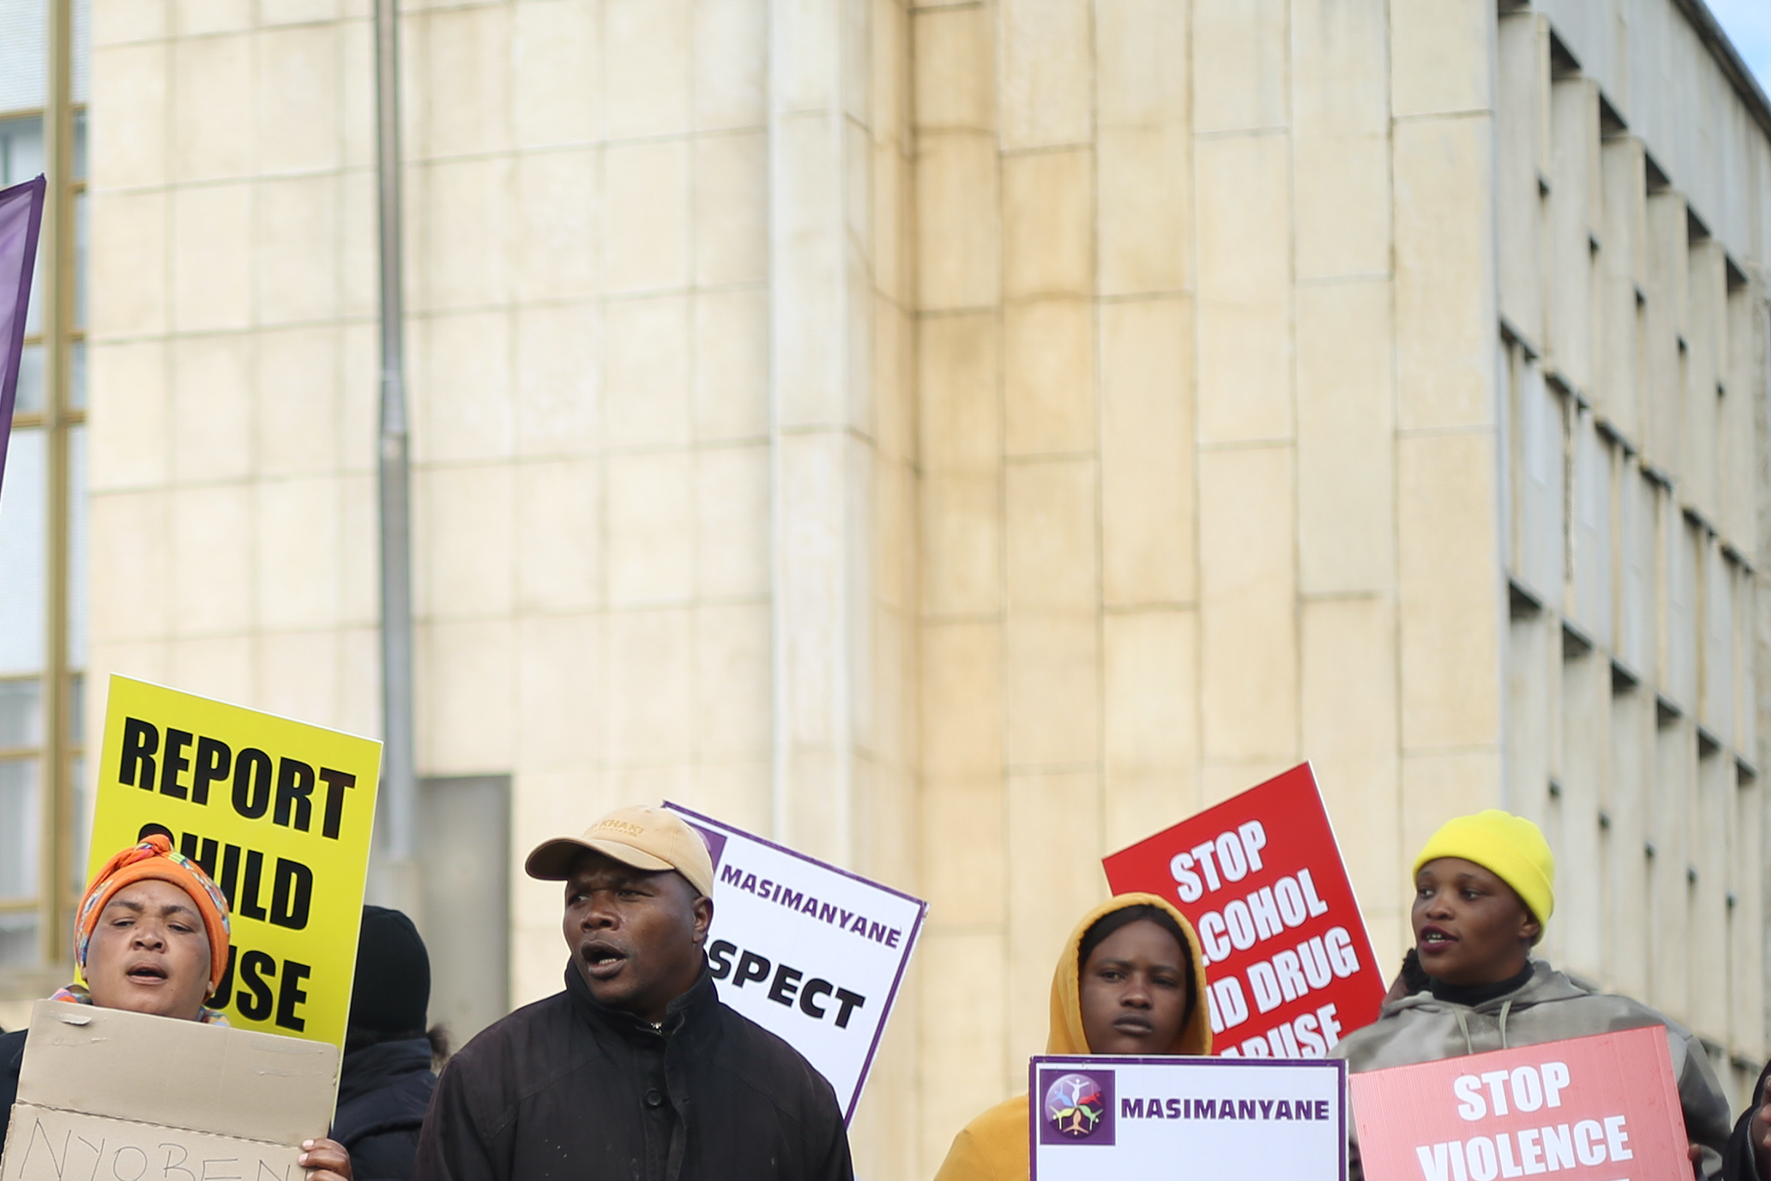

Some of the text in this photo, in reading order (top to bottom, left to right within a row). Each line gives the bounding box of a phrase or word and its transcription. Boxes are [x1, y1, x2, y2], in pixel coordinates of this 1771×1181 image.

[118, 716, 356, 840] REPORT
[1170, 819, 1267, 903] STOP
[720, 864, 903, 948] MASIMANYANE
[1198, 868, 1328, 967] COHOL
[204, 945, 311, 1033] USE
[705, 934, 866, 1030] SPECT
[1246, 926, 1360, 1014] DRUG
[1121, 1098, 1330, 1121] MASIMANYANE
[1453, 1062, 1570, 1121] STOP
